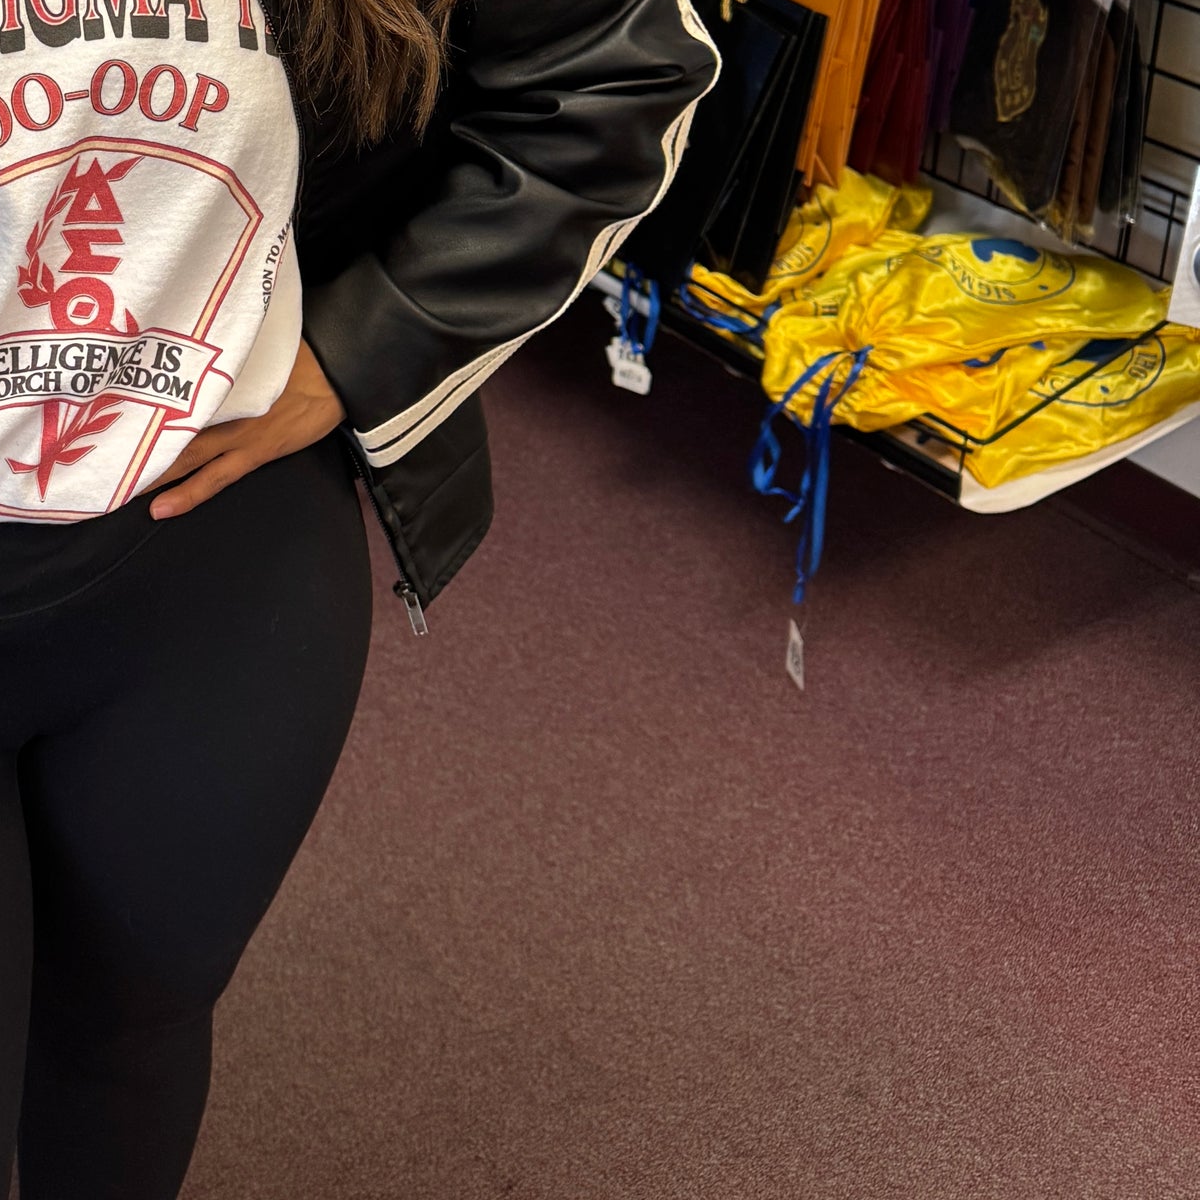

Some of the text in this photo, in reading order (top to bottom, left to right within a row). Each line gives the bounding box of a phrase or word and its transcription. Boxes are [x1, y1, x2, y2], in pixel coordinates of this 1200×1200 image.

[265, 244, 281, 265] TO
[152, 342, 183, 373] IS
[70, 371, 106, 394] OF
[104, 366, 194, 402] WISDOM
